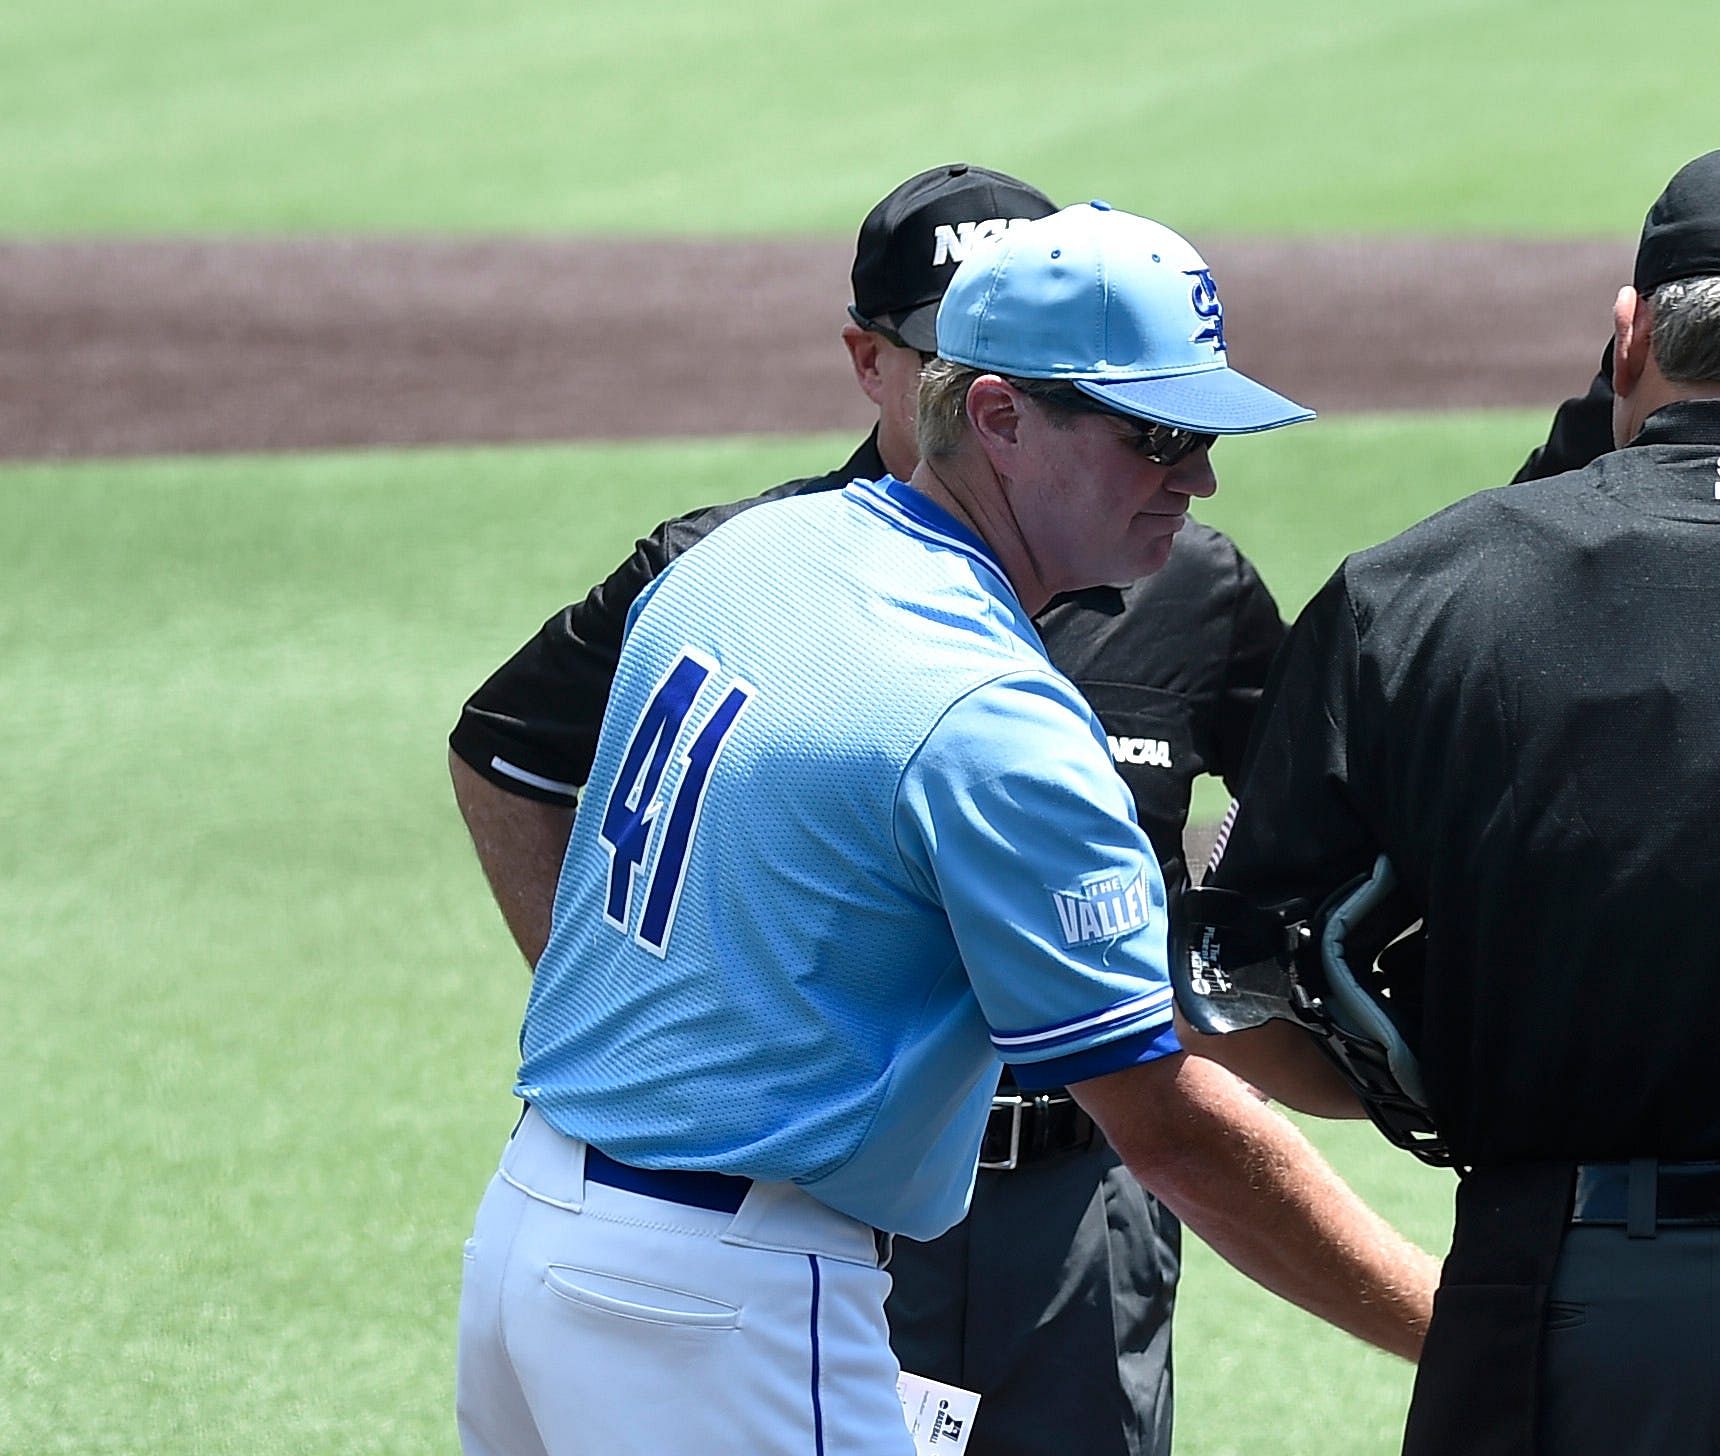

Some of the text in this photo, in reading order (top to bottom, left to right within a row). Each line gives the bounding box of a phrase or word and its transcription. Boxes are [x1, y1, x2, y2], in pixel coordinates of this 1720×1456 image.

[598, 643, 756, 960] 41
[1053, 866, 1150, 944] VALLEY
[1087, 877, 1122, 897] THE
